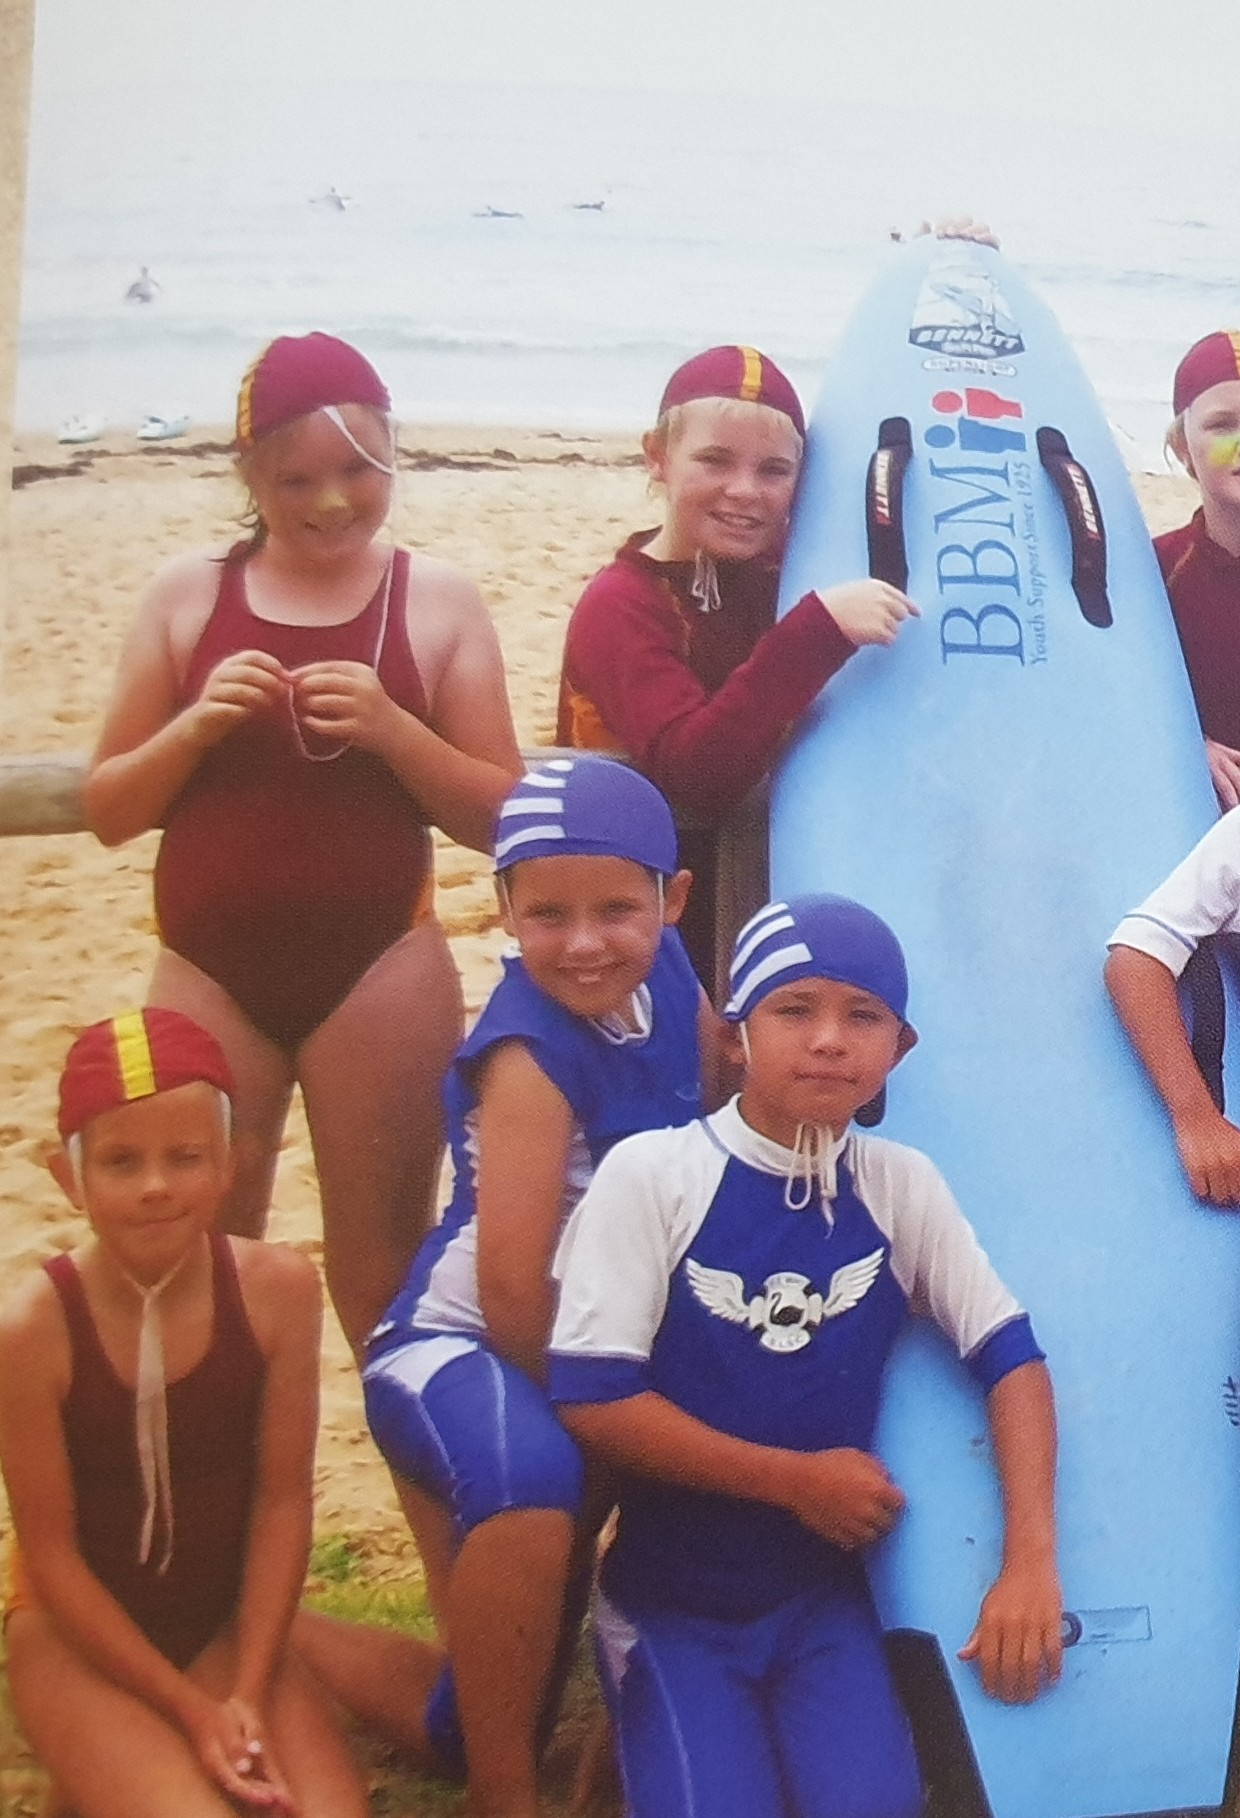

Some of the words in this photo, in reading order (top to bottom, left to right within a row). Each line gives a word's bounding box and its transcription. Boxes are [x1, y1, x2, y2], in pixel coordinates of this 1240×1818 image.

[1013, 461, 1032, 496] 1925
[1021, 503, 1037, 543] Since
[928, 457, 1025, 667] BBM
[1025, 544, 1048, 608] Support
[1028, 613, 1048, 665] Youth
